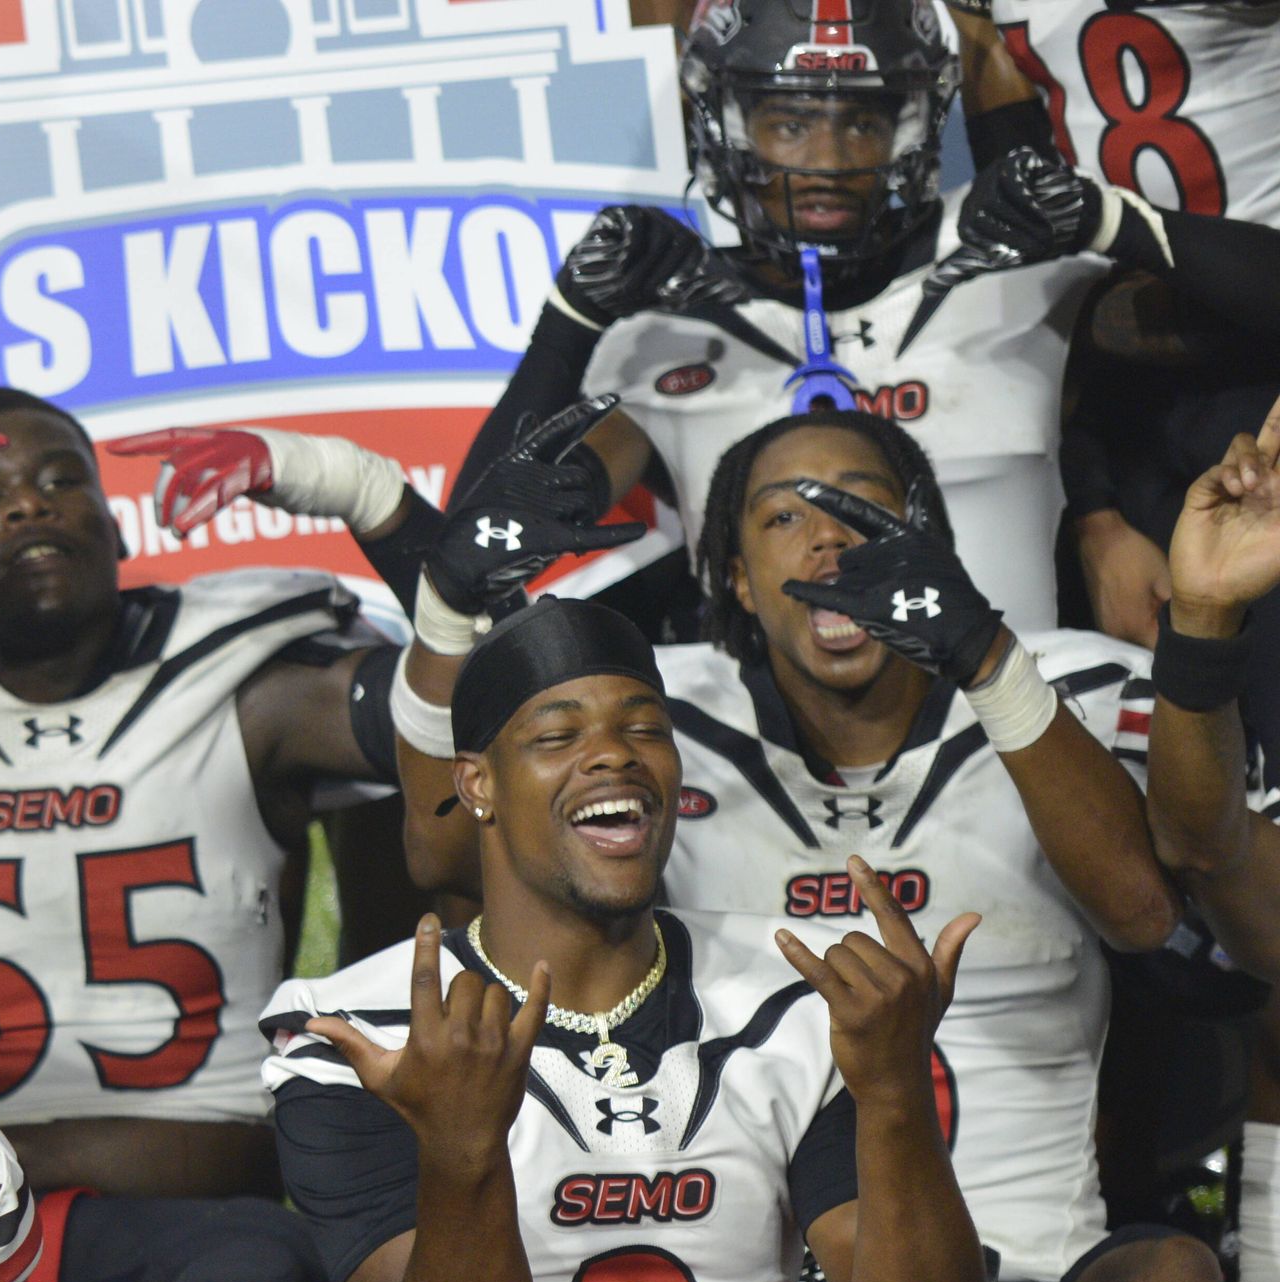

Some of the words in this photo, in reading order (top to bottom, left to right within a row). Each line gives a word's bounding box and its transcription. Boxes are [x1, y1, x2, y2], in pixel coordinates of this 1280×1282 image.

[795, 52, 868, 71] SEMO
[854, 382, 927, 420] MO
[591, 1043, 639, 1088] 2
[550, 1168, 716, 1227] SEMO
